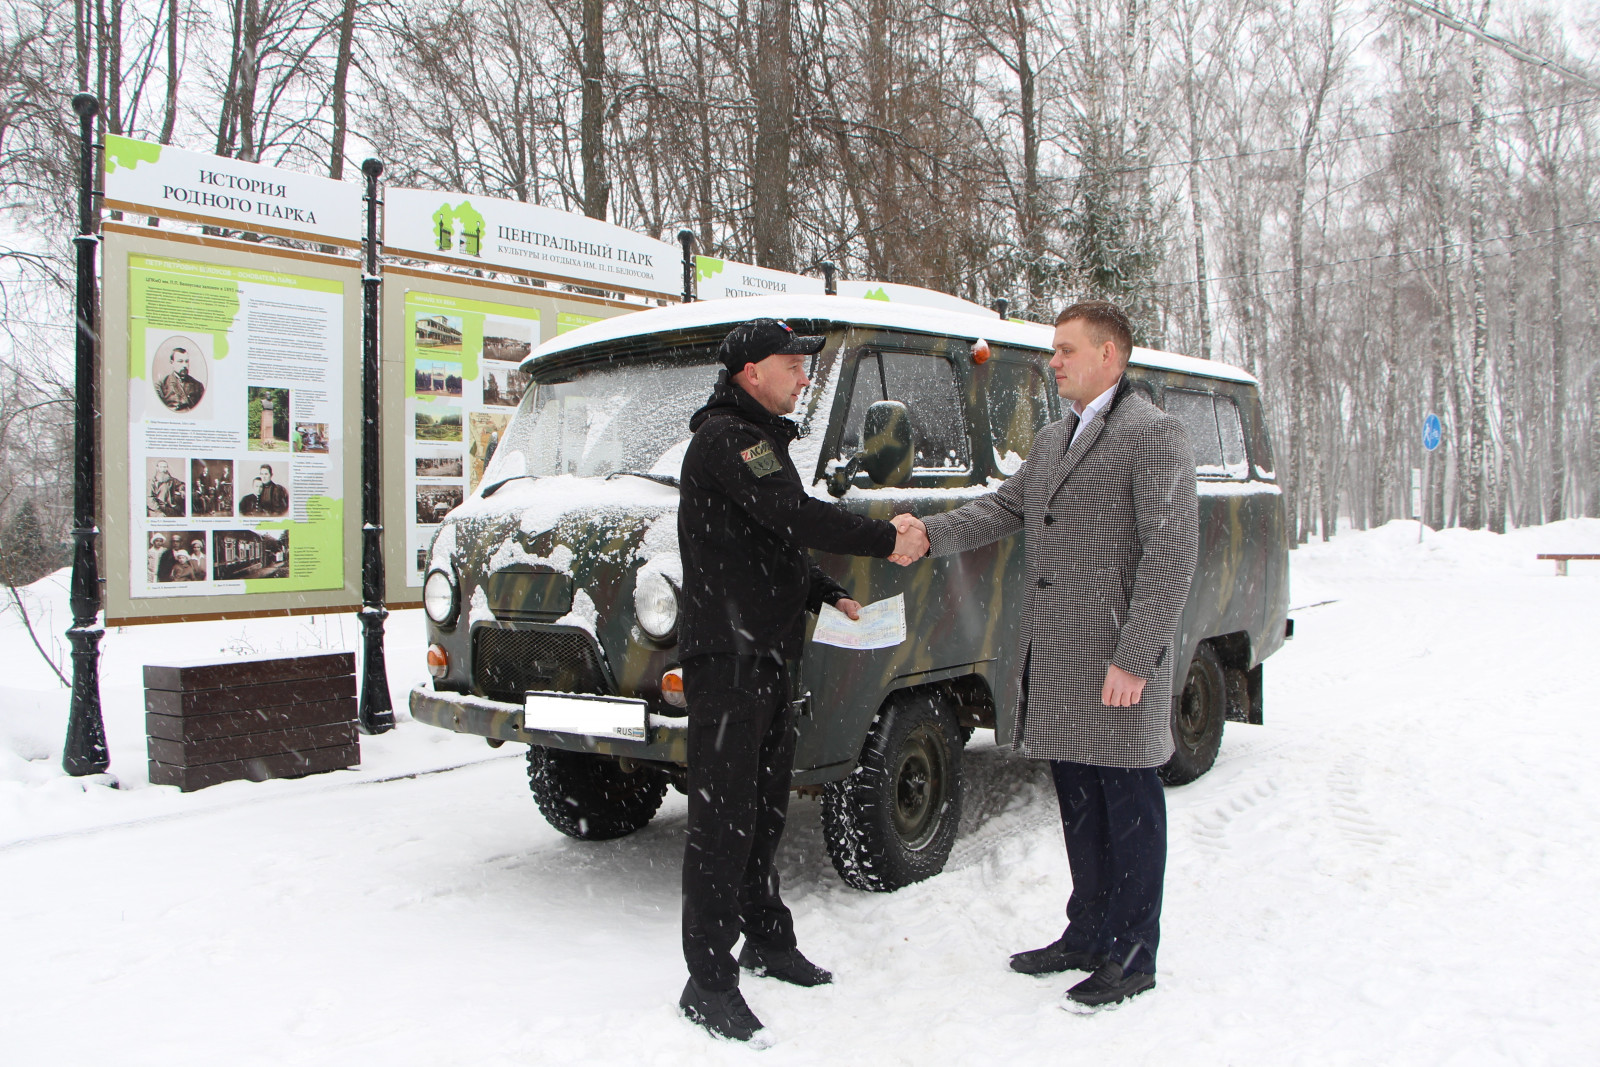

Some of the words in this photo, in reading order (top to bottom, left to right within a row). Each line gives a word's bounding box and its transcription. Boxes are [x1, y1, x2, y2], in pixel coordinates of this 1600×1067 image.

[199, 169, 287, 198] ИСТОРИЯ
[162, 185, 252, 213] РОДНОГО
[256, 202, 317, 225] ПАРКА
[498, 225, 613, 259] ЦЕНТРАЛЬНЫЙ
[617, 248, 654, 267] ПАРК
[498, 245, 540, 260] КУЛЬТУРЫ
[542, 253, 548, 261] И
[549, 254, 582, 267] ОТДЫХА
[583, 260, 597, 270] ИМ.
[598, 263, 607, 272] П.
[607, 264, 615, 273] П.
[615, 266, 655, 280] БЕЛОУСОВА
[725, 287, 764, 298] РОДН
[742, 275, 787, 292] ИСТОРИЯ
[616, 727, 632, 736] RUS
